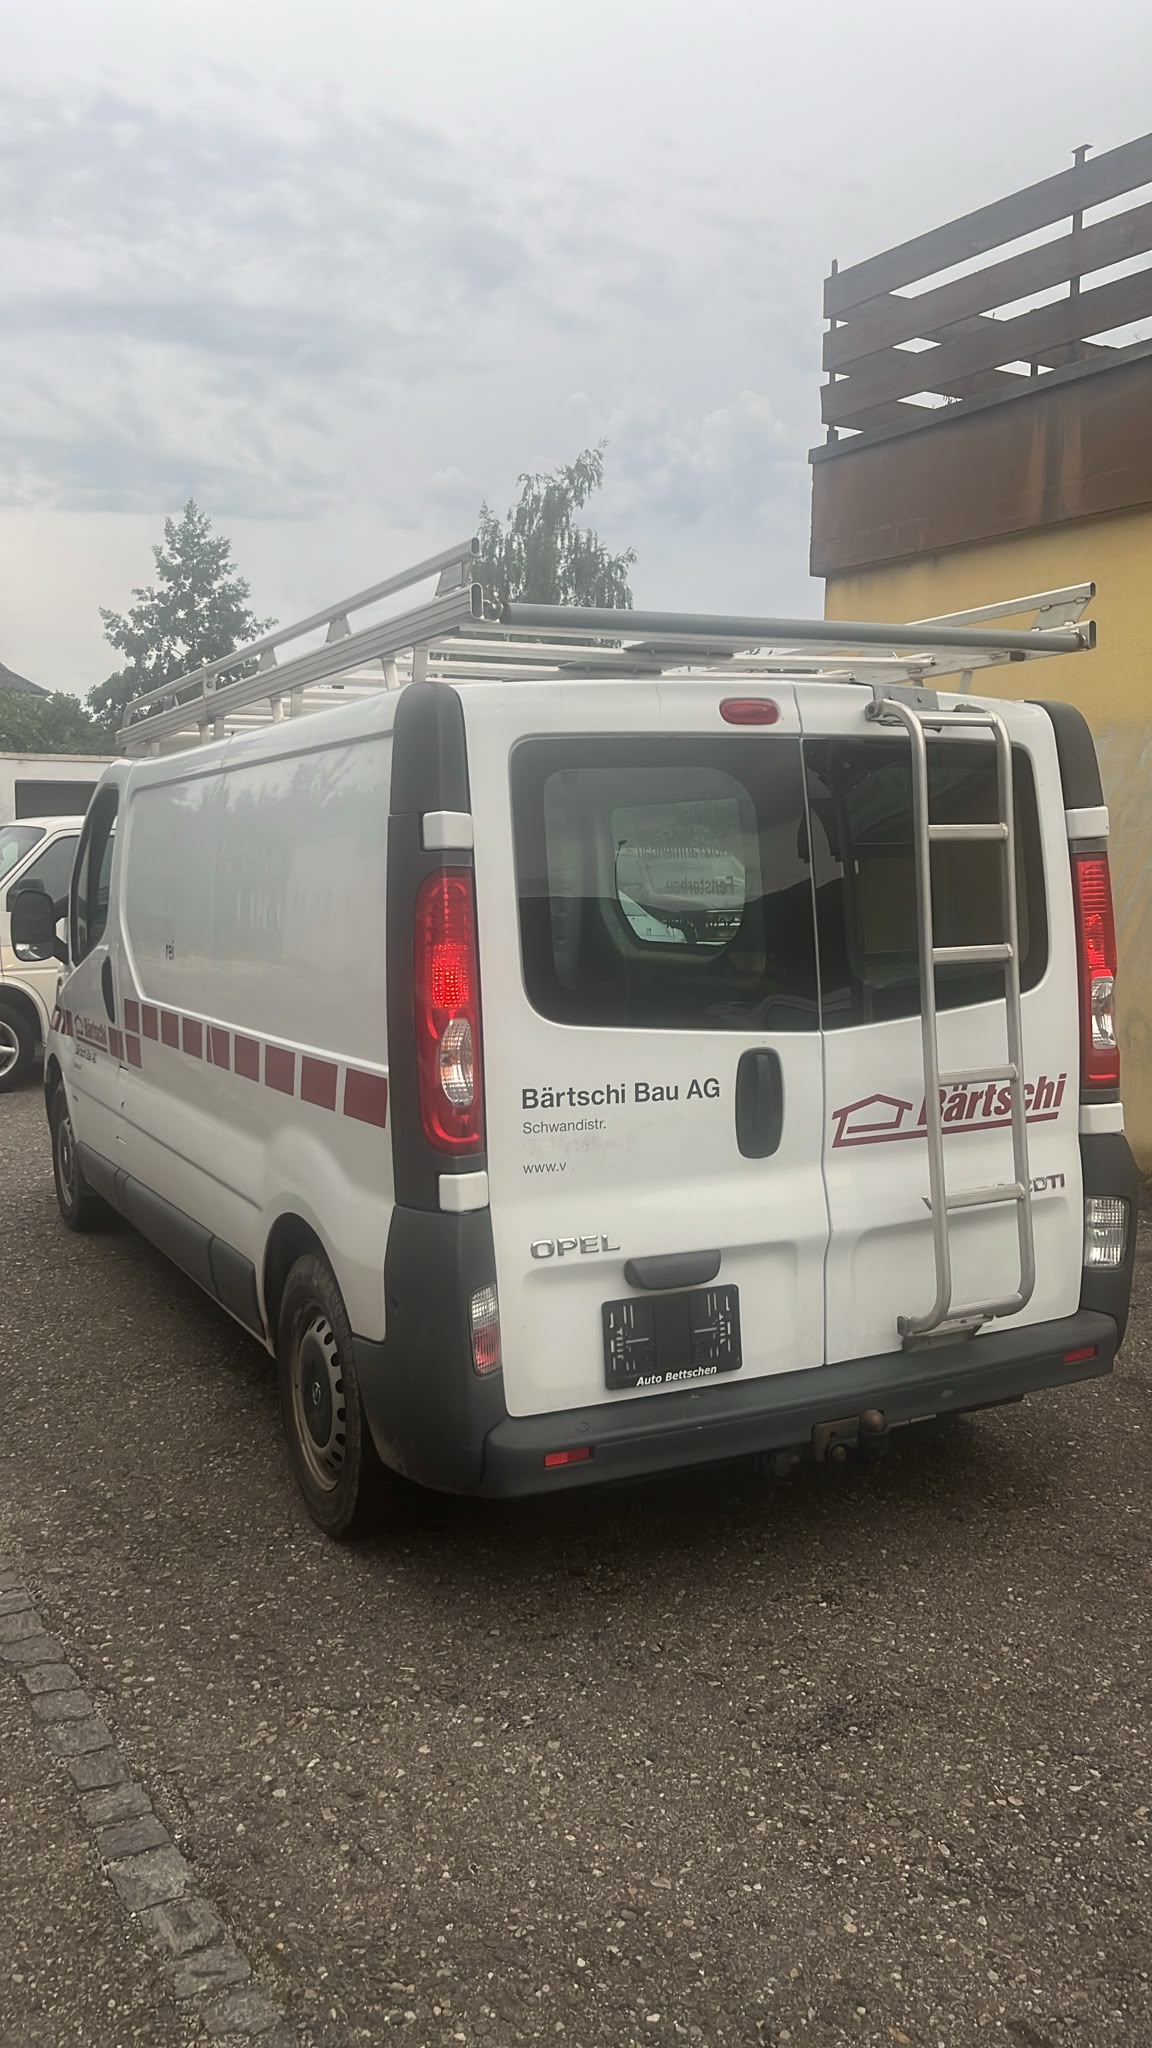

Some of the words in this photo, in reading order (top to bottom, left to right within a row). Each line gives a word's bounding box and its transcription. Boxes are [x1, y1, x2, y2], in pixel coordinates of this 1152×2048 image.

[522, 1083, 626, 1110] Bärtschi
[634, 1082, 679, 1103] Bau
[686, 1077, 721, 1100] AG
[522, 1118, 607, 1135] Schwandistr.
[523, 1162, 567, 1174] www.v
[1029, 1172, 1066, 1193] DTI
[530, 1233, 620, 1259] OPEL
[636, 1374, 662, 1387] Auto
[665, 1365, 717, 1382] Bettschen
